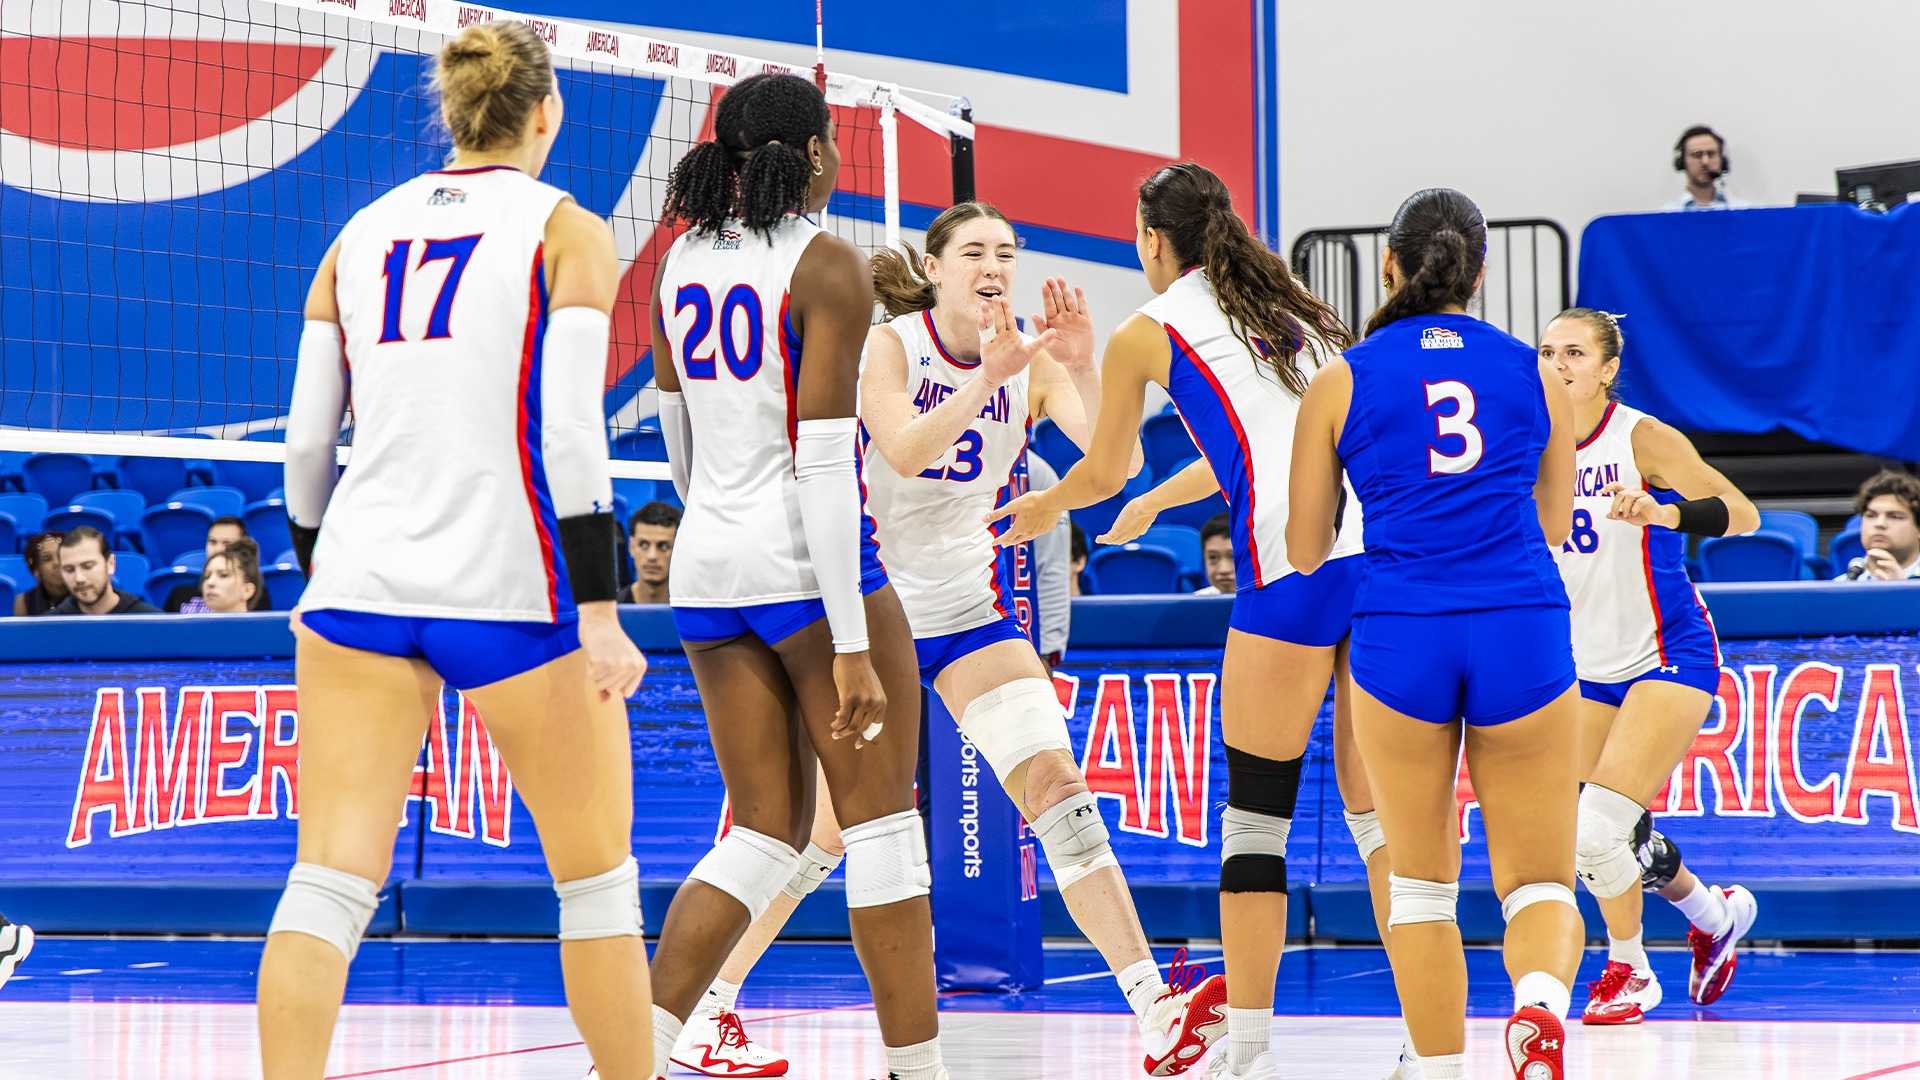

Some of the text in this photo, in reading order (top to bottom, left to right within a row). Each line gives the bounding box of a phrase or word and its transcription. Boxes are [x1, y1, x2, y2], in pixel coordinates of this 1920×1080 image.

[586, 30, 620, 58] AMERICAN
[646, 42, 680, 69] AMERICAN
[705, 53, 737, 79] AMERICAN
[376, 231, 485, 345] 17
[674, 282, 764, 382] 20
[912, 377, 1010, 424] AMEAN
[1422, 378, 1485, 479] 3
[915, 428, 984, 483] 3
[1574, 462, 1619, 498] ICAN
[1562, 508, 1600, 554] 8
[65, 684, 512, 848] AMERAN
[958, 789, 983, 879] imports
